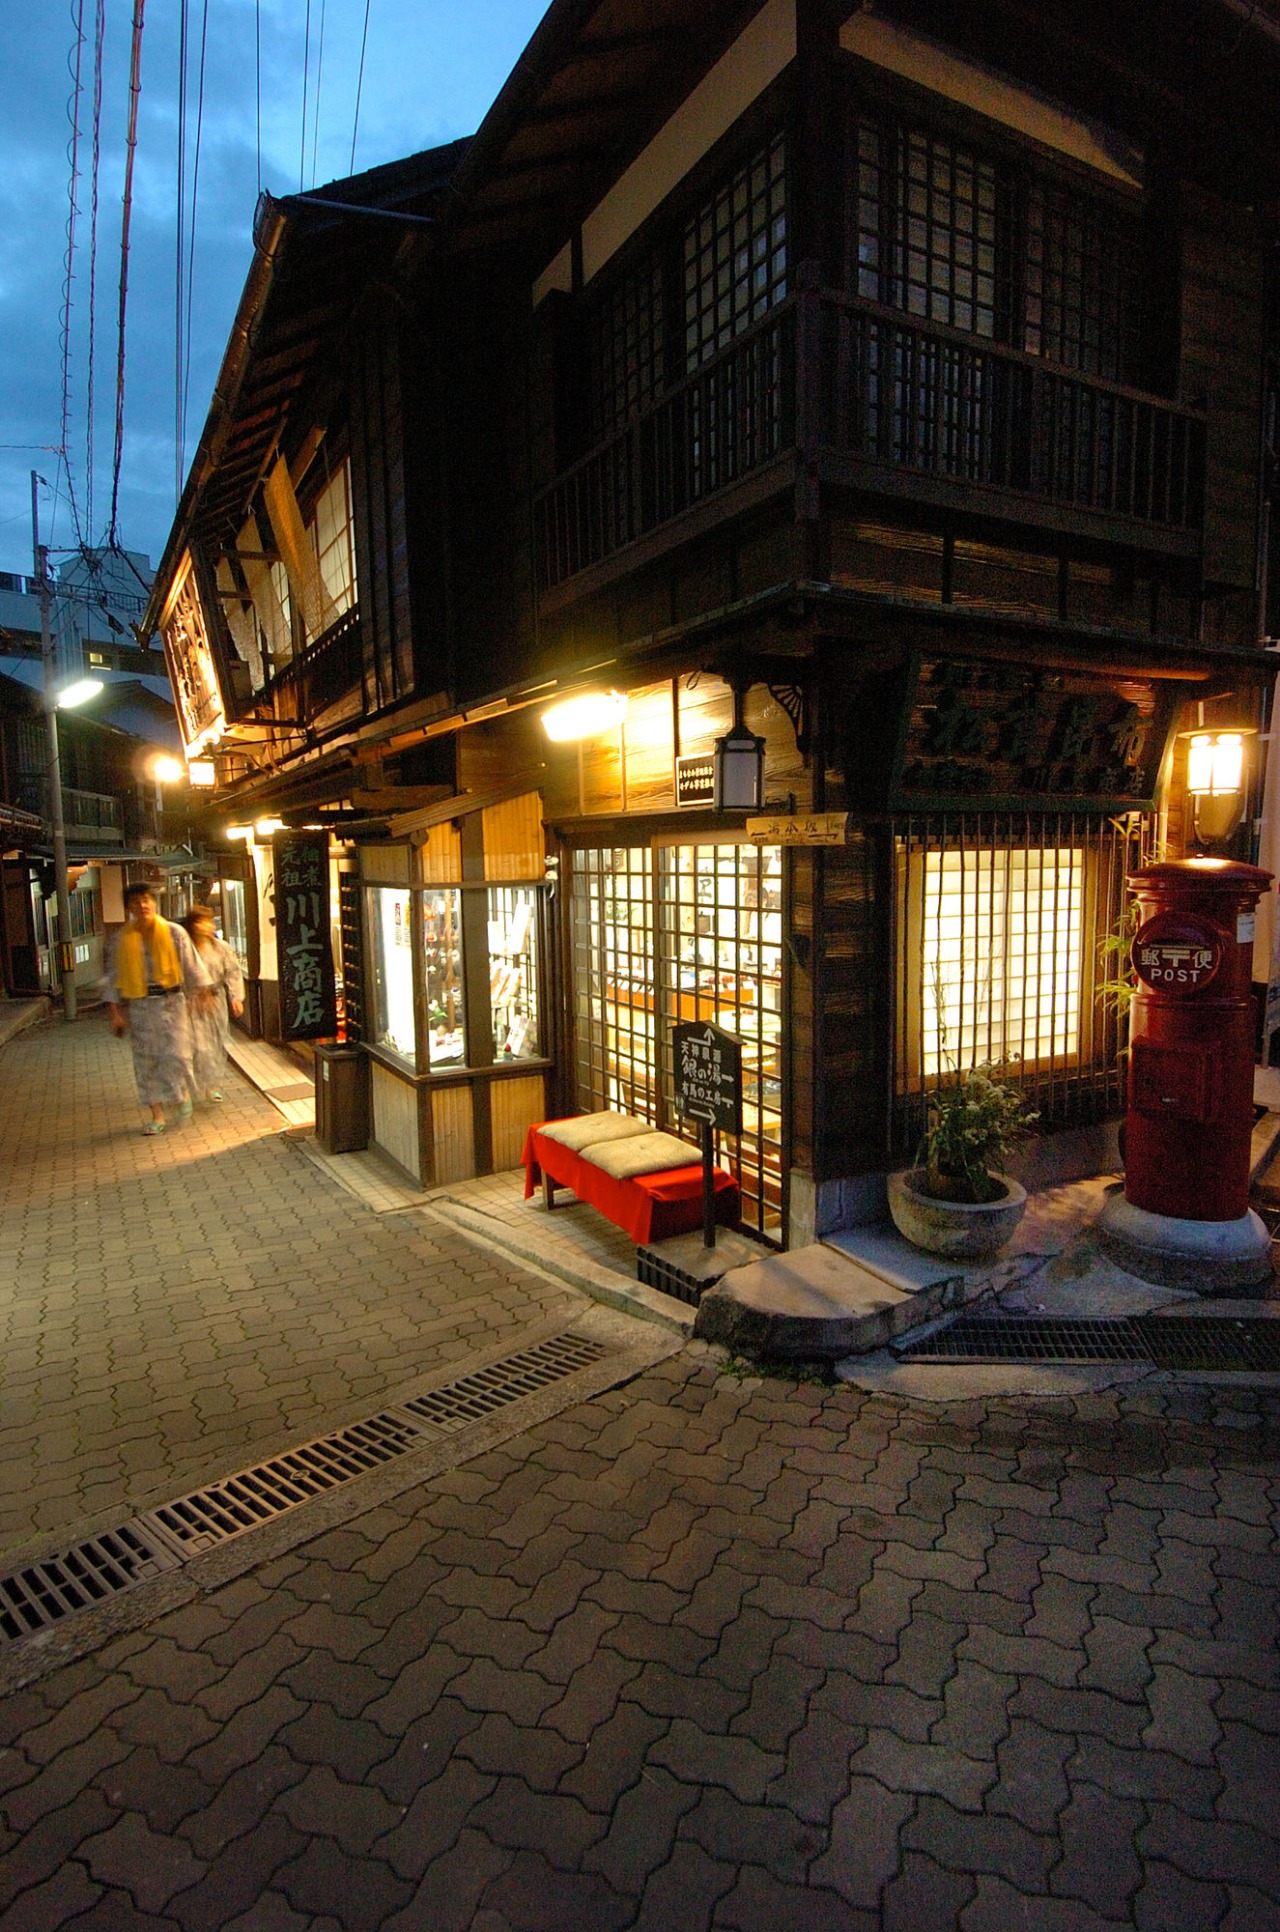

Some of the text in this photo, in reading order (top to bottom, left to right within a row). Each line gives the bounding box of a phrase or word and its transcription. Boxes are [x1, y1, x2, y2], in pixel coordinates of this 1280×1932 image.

[280, 845, 302, 887] 元祖
[286, 892, 325, 1029] 川上商店
[1151, 968, 1201, 983] POST
[681, 1054, 722, 1086] 銀の湯
[681, 1080, 722, 1106] 有馬の工房
